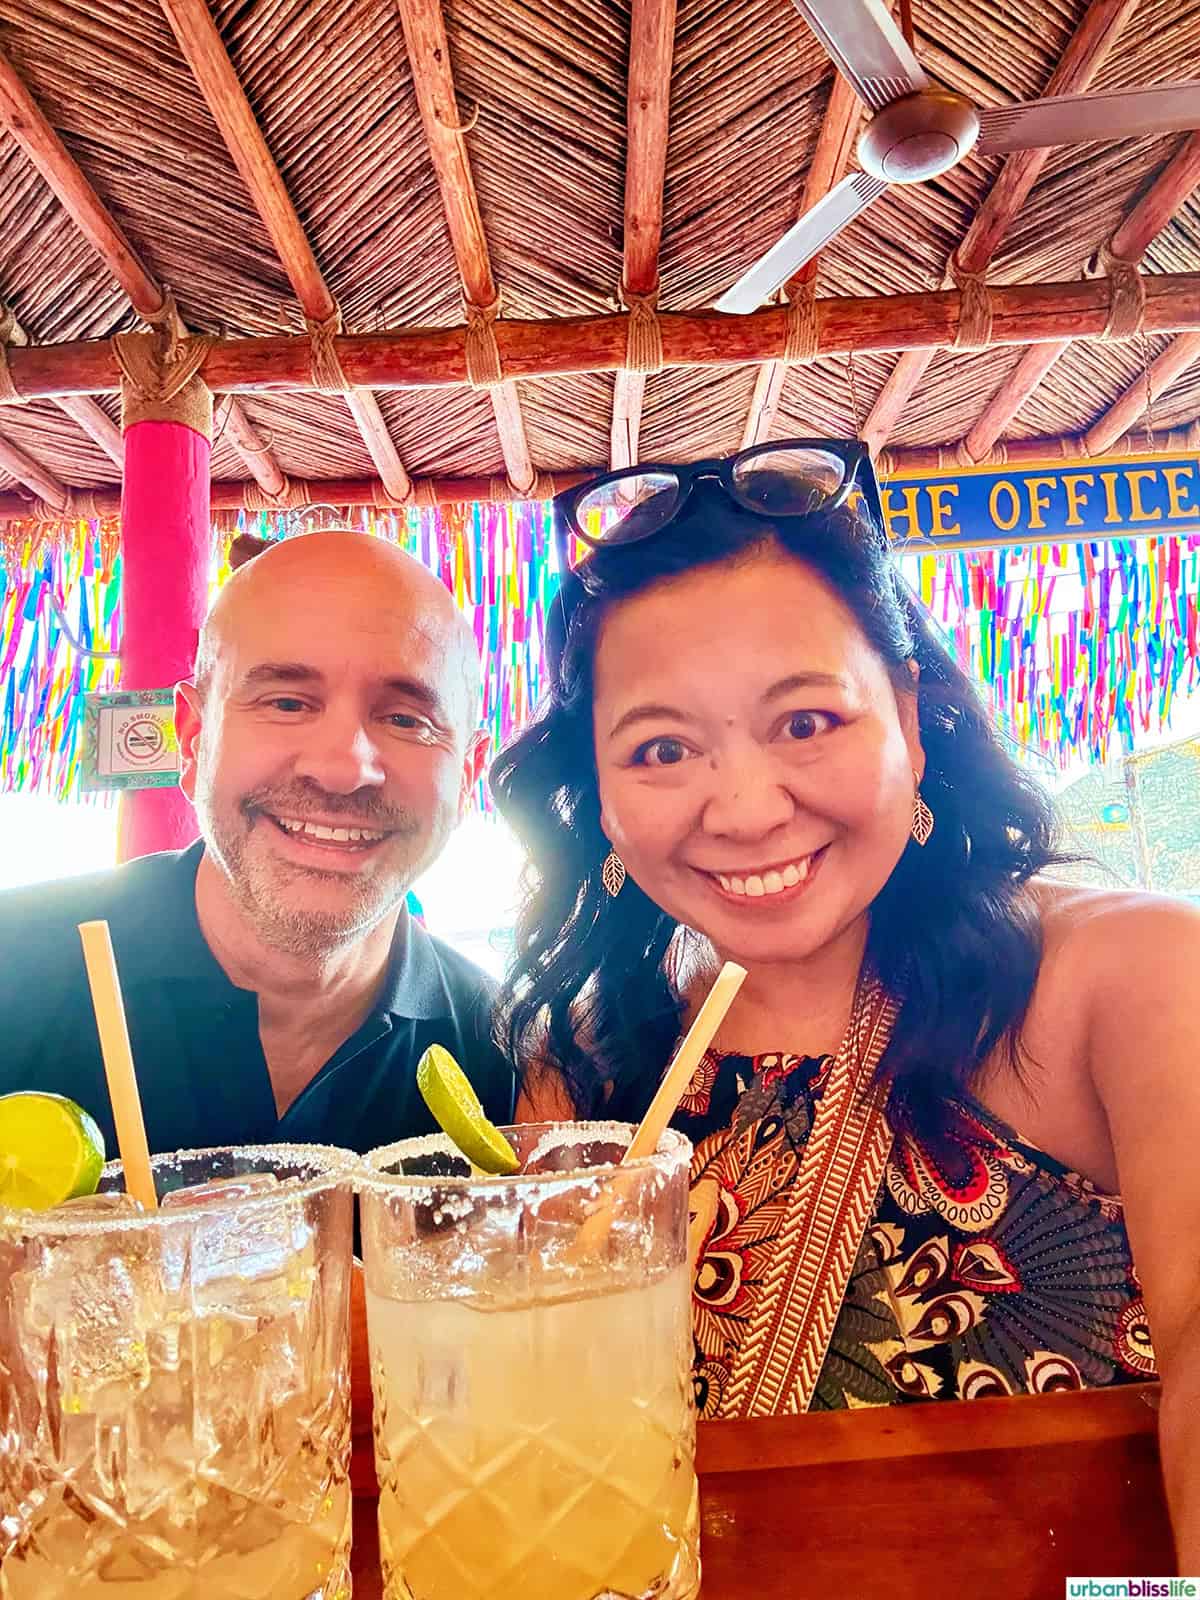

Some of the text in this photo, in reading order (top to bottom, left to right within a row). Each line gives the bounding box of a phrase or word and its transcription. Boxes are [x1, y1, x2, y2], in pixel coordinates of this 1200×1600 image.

[989, 467, 1198, 531] OFFICE
[118, 713, 170, 734] NO SMOKIN
